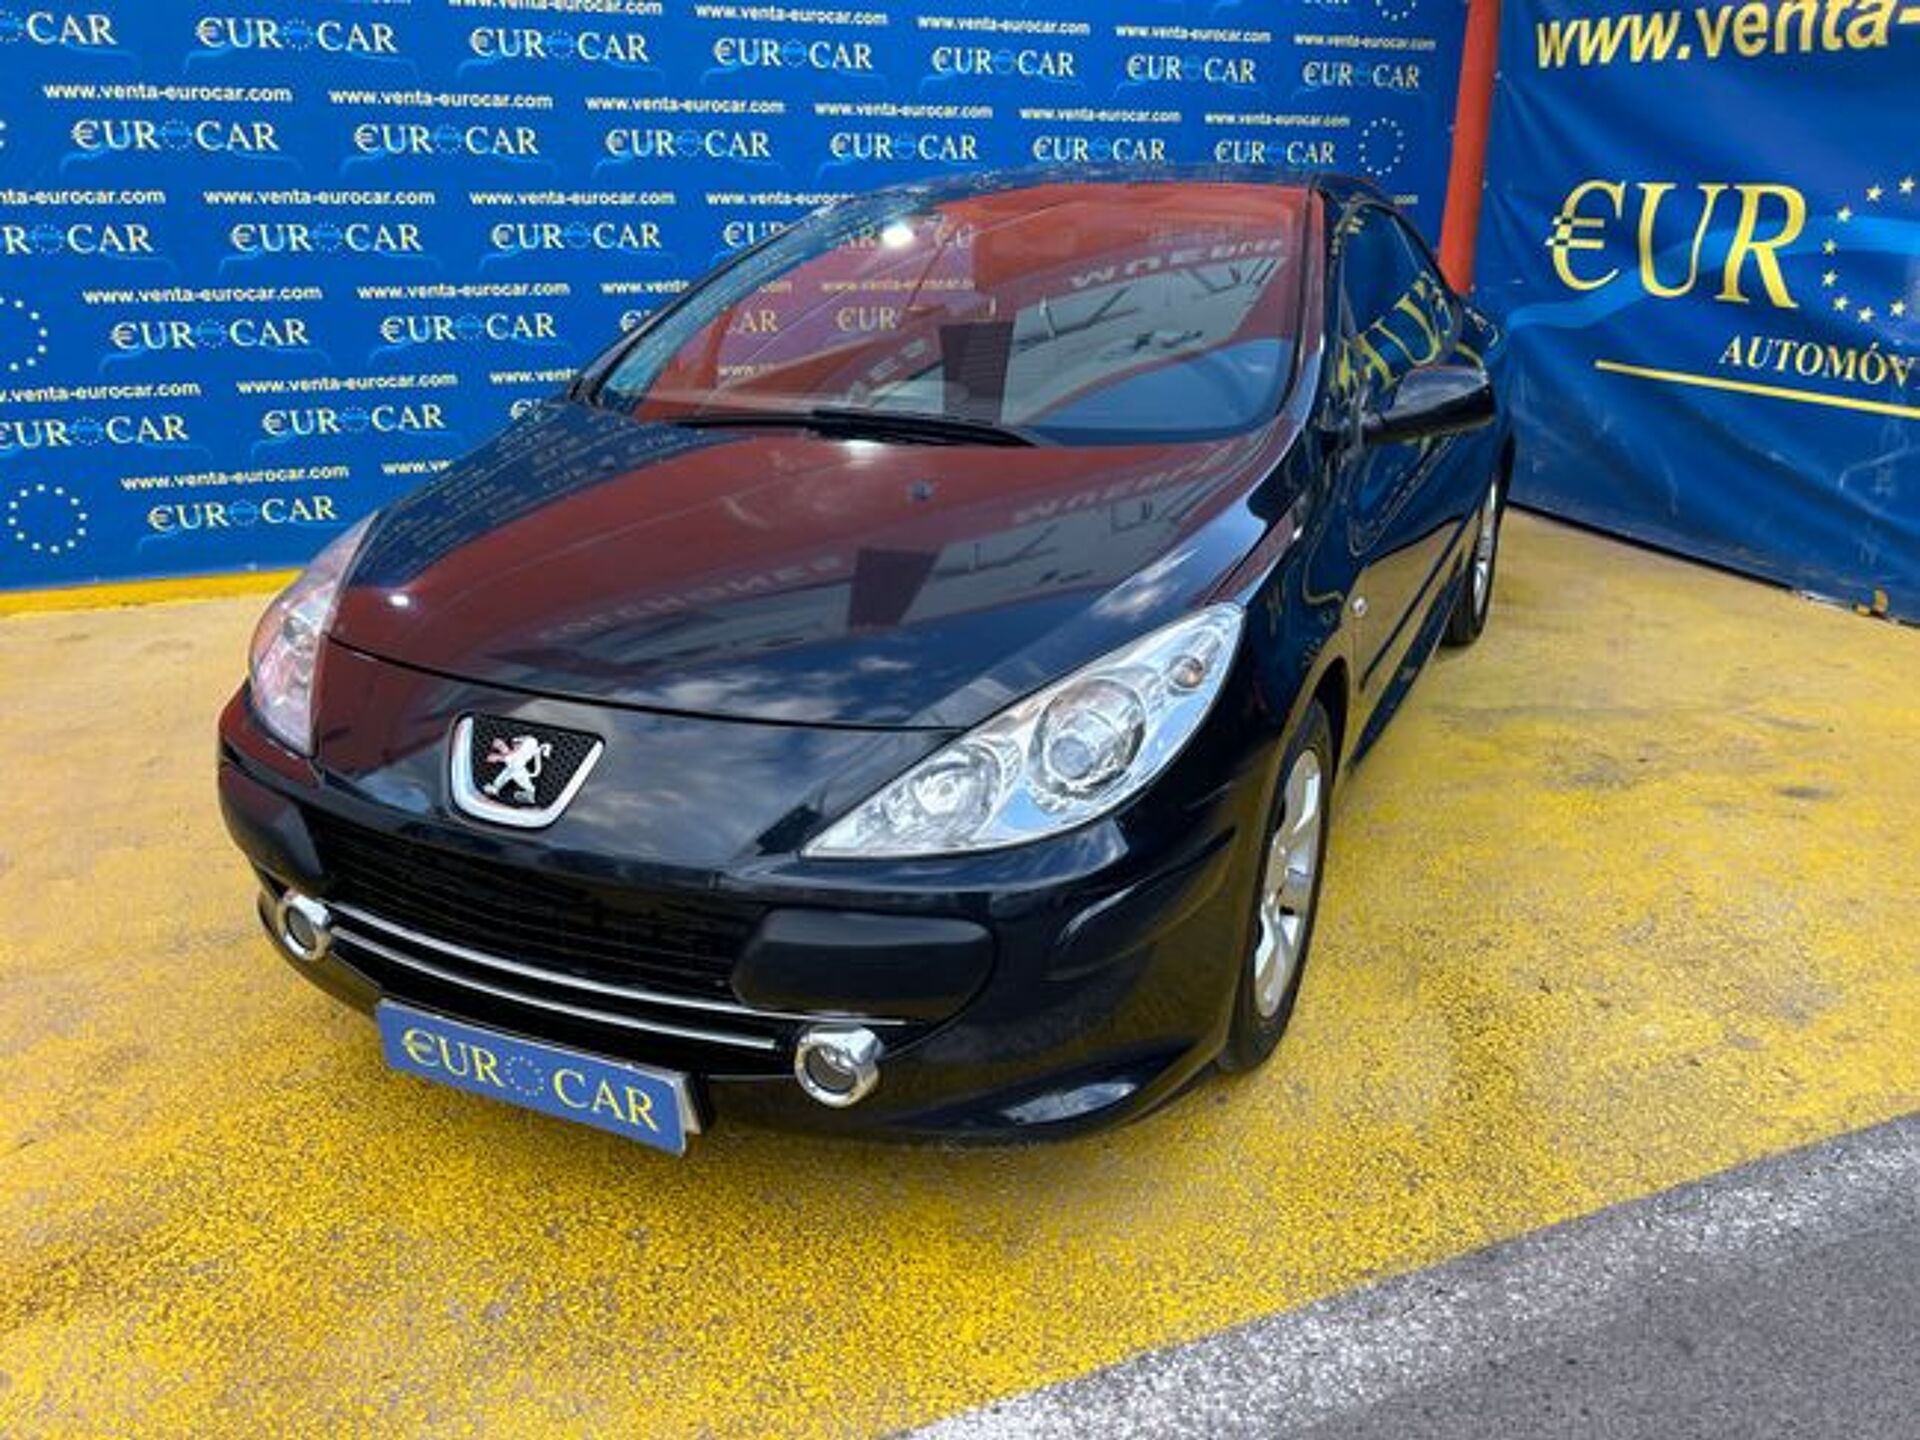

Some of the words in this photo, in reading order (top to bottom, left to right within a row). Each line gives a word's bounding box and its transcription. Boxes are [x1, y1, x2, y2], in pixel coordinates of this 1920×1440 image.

[694, 2, 889, 26] www.venta-eurocar.com
[917, 14, 1091, 36] www.venta-eurocar.com
[1115, 24, 1272, 43] www.venta-eurocar.com
[1293, 33, 1437, 51] www.venta-eurocar.com
[43, 82, 293, 102] www.venta-eurocar.com
[328, 89, 554, 109] www.venta-eurocar.com
[585, 97, 785, 114] www.venta-eurocar.com
[814, 102, 993, 120] www.venta-eurocar.com
[1018, 107, 1183, 124] www.venta-eurocar.com
[1204, 111, 1351, 127] www.venta-eurocar.com
[203, 189, 435, 206] www.venta-eurocar.com
[469, 189, 676, 206] www.venta-eurocar.com
[82, 286, 323, 305] www.venta-eurocar.com
[357, 282, 571, 300] www.venta-eurocar.com
[1718, 334, 1920, 390] AUTOMÓV
[236, 373, 459, 394] www.venta-eurocar.com
[121, 465, 350, 491] www.venta-eurocar.com
